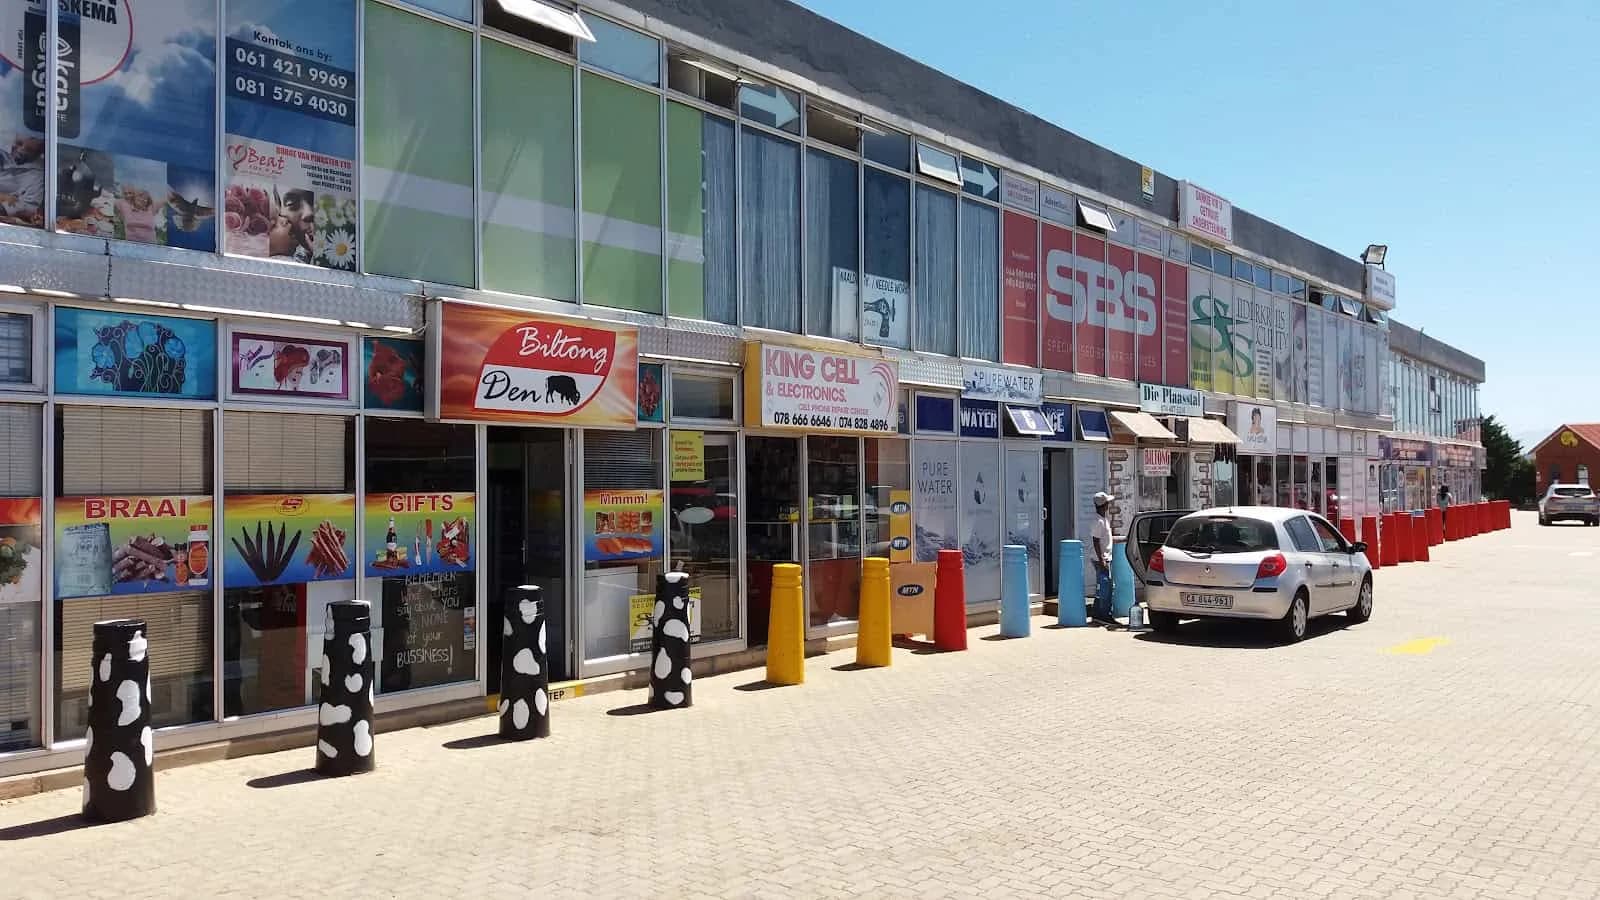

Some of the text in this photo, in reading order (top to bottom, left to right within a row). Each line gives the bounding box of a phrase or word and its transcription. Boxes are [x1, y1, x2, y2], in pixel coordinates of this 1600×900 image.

[253, 30, 333, 63] Kontak ons by:
[235, 47, 348, 89] 061 421 9969
[235, 76, 347, 117] 081 575 4030
[1046, 249, 1157, 337] SBS
[516, 327, 609, 374] Biltong
[766, 349, 860, 385] KING CELL
[481, 369, 541, 403] Den
[766, 381, 774, 396] &
[1143, 385, 1201, 407] Die Plaasstal
[774, 411, 790, 425] 078
[792, 413, 808, 426] 666
[810, 414, 832, 428] 6646
[838, 417, 852, 429] 074
[854, 418, 868, 430] 828
[870, 418, 889, 432] 4896
[960, 407, 998, 428] WATER
[1144, 448, 1170, 465] BILTONG
[922, 462, 949, 477] PURE
[917, 479, 953, 495] WATER
[85, 498, 188, 519] BRAAI
[389, 494, 454, 513] GIFTS
[600, 492, 648, 505] Mmmm!
[893, 504, 907, 513] MTN
[893, 539, 907, 547] MTN
[901, 586, 919, 595] MTN
[547, 690, 565, 701] TEP
